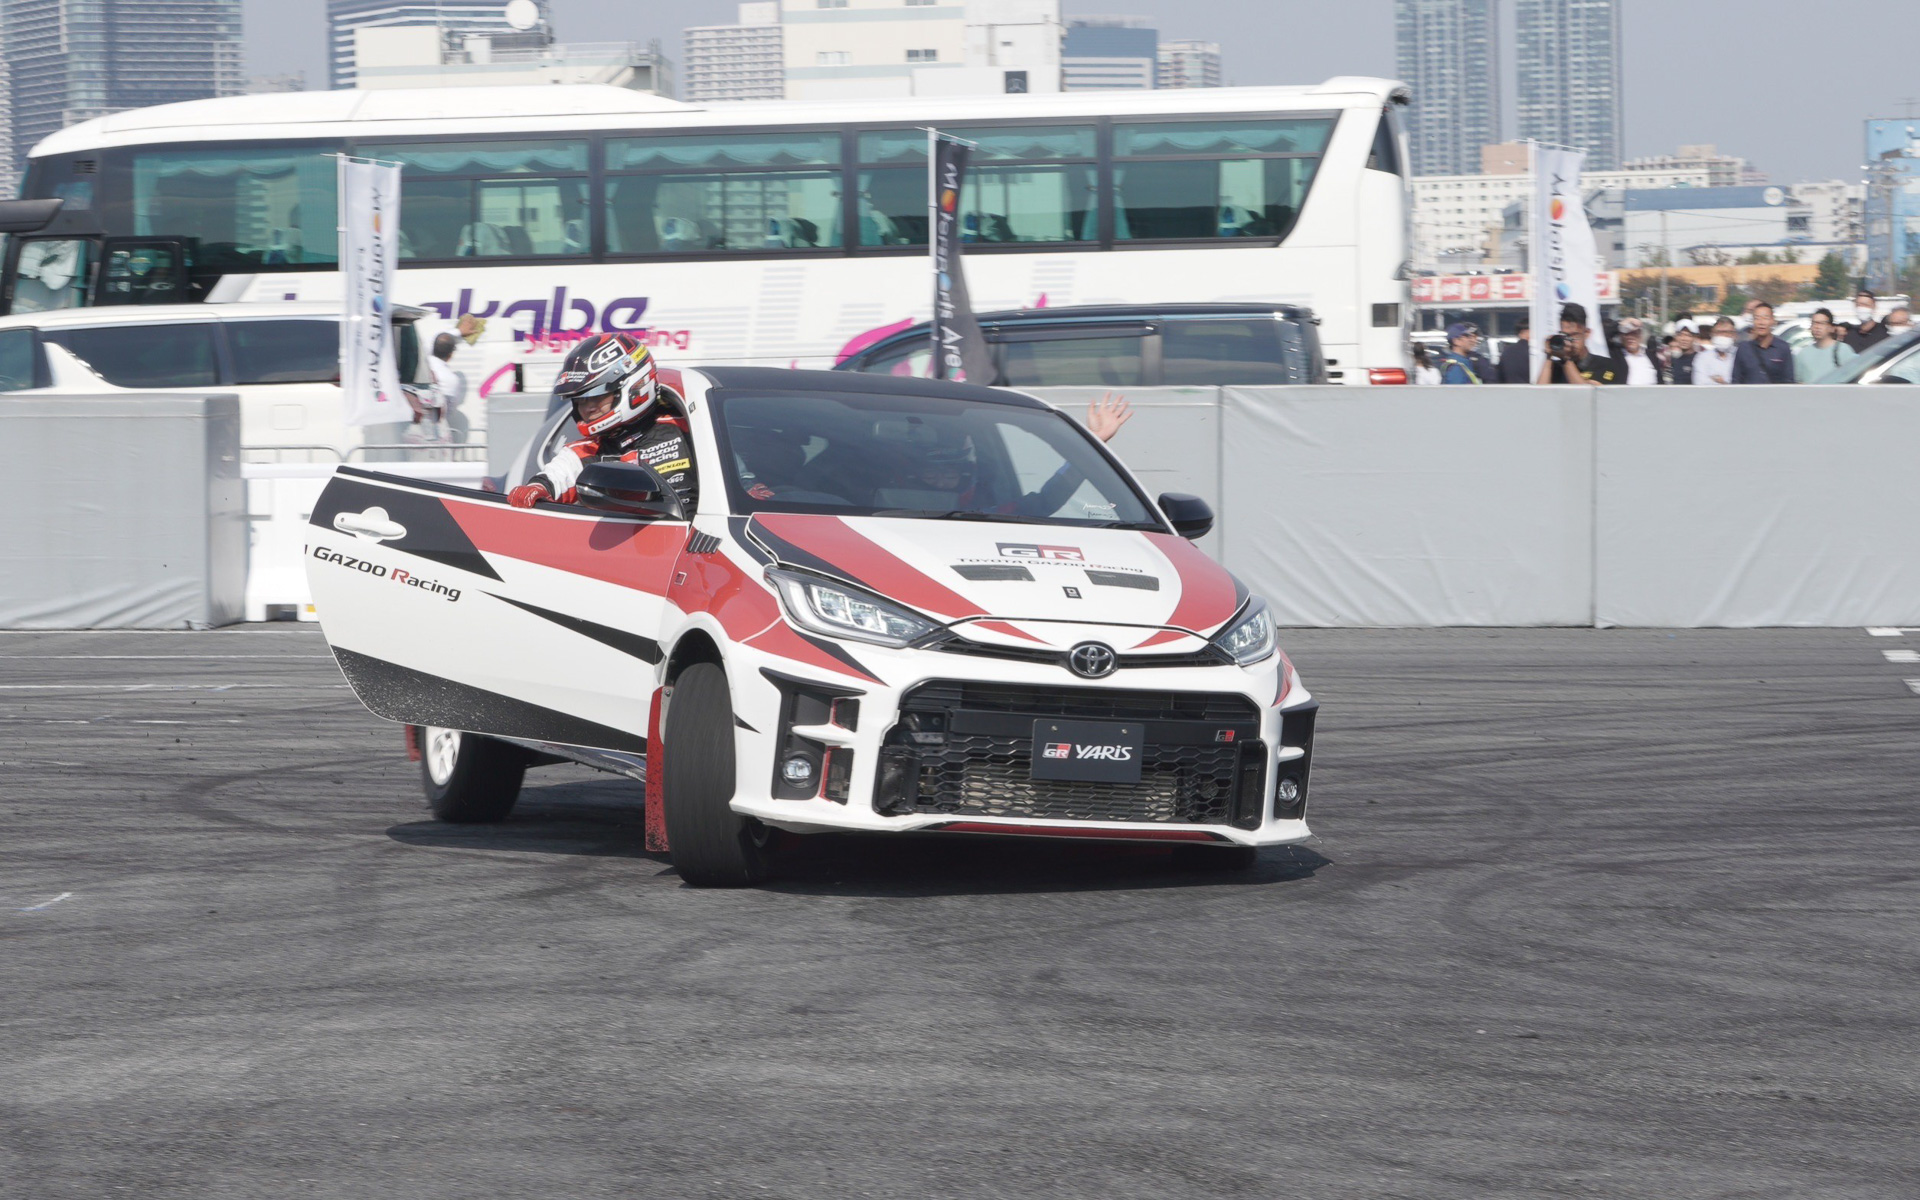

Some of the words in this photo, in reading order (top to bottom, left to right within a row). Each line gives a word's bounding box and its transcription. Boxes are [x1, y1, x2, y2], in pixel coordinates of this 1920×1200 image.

[639, 437, 682, 454] TOYOTA
[639, 444, 679, 460] GAZOO
[999, 546, 1083, 560] GR
[313, 546, 387, 577] GAZOO
[390, 567, 462, 602] Racing
[1028, 560, 1086, 568] GAZOO
[1090, 564, 1144, 573] Racing
[1043, 747, 1070, 759] GR
